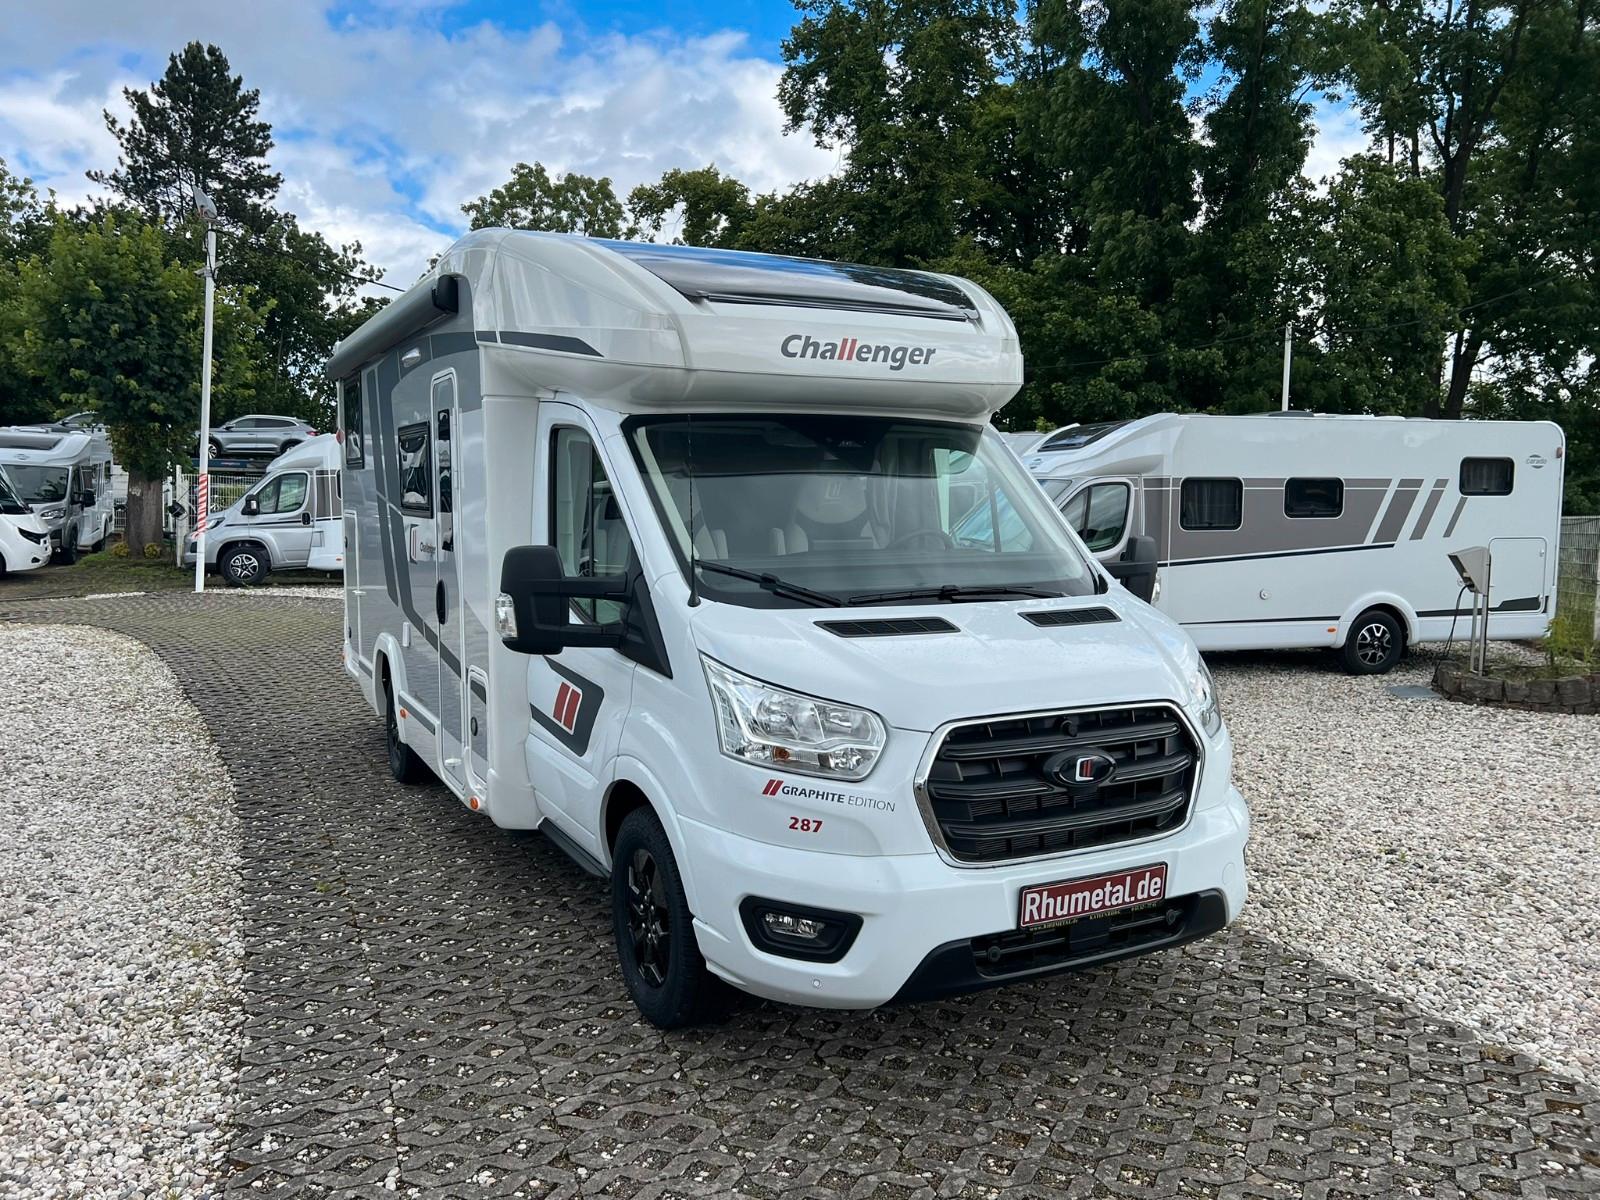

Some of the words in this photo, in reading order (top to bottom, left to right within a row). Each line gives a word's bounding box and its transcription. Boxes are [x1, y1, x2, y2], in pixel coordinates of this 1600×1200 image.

[780, 334, 936, 371] Challenger
[781, 785, 846, 804] GRAPHITE
[847, 795, 896, 812] EDITION
[788, 816, 823, 833] 287
[1024, 871, 1162, 922] Rhumetal.de
